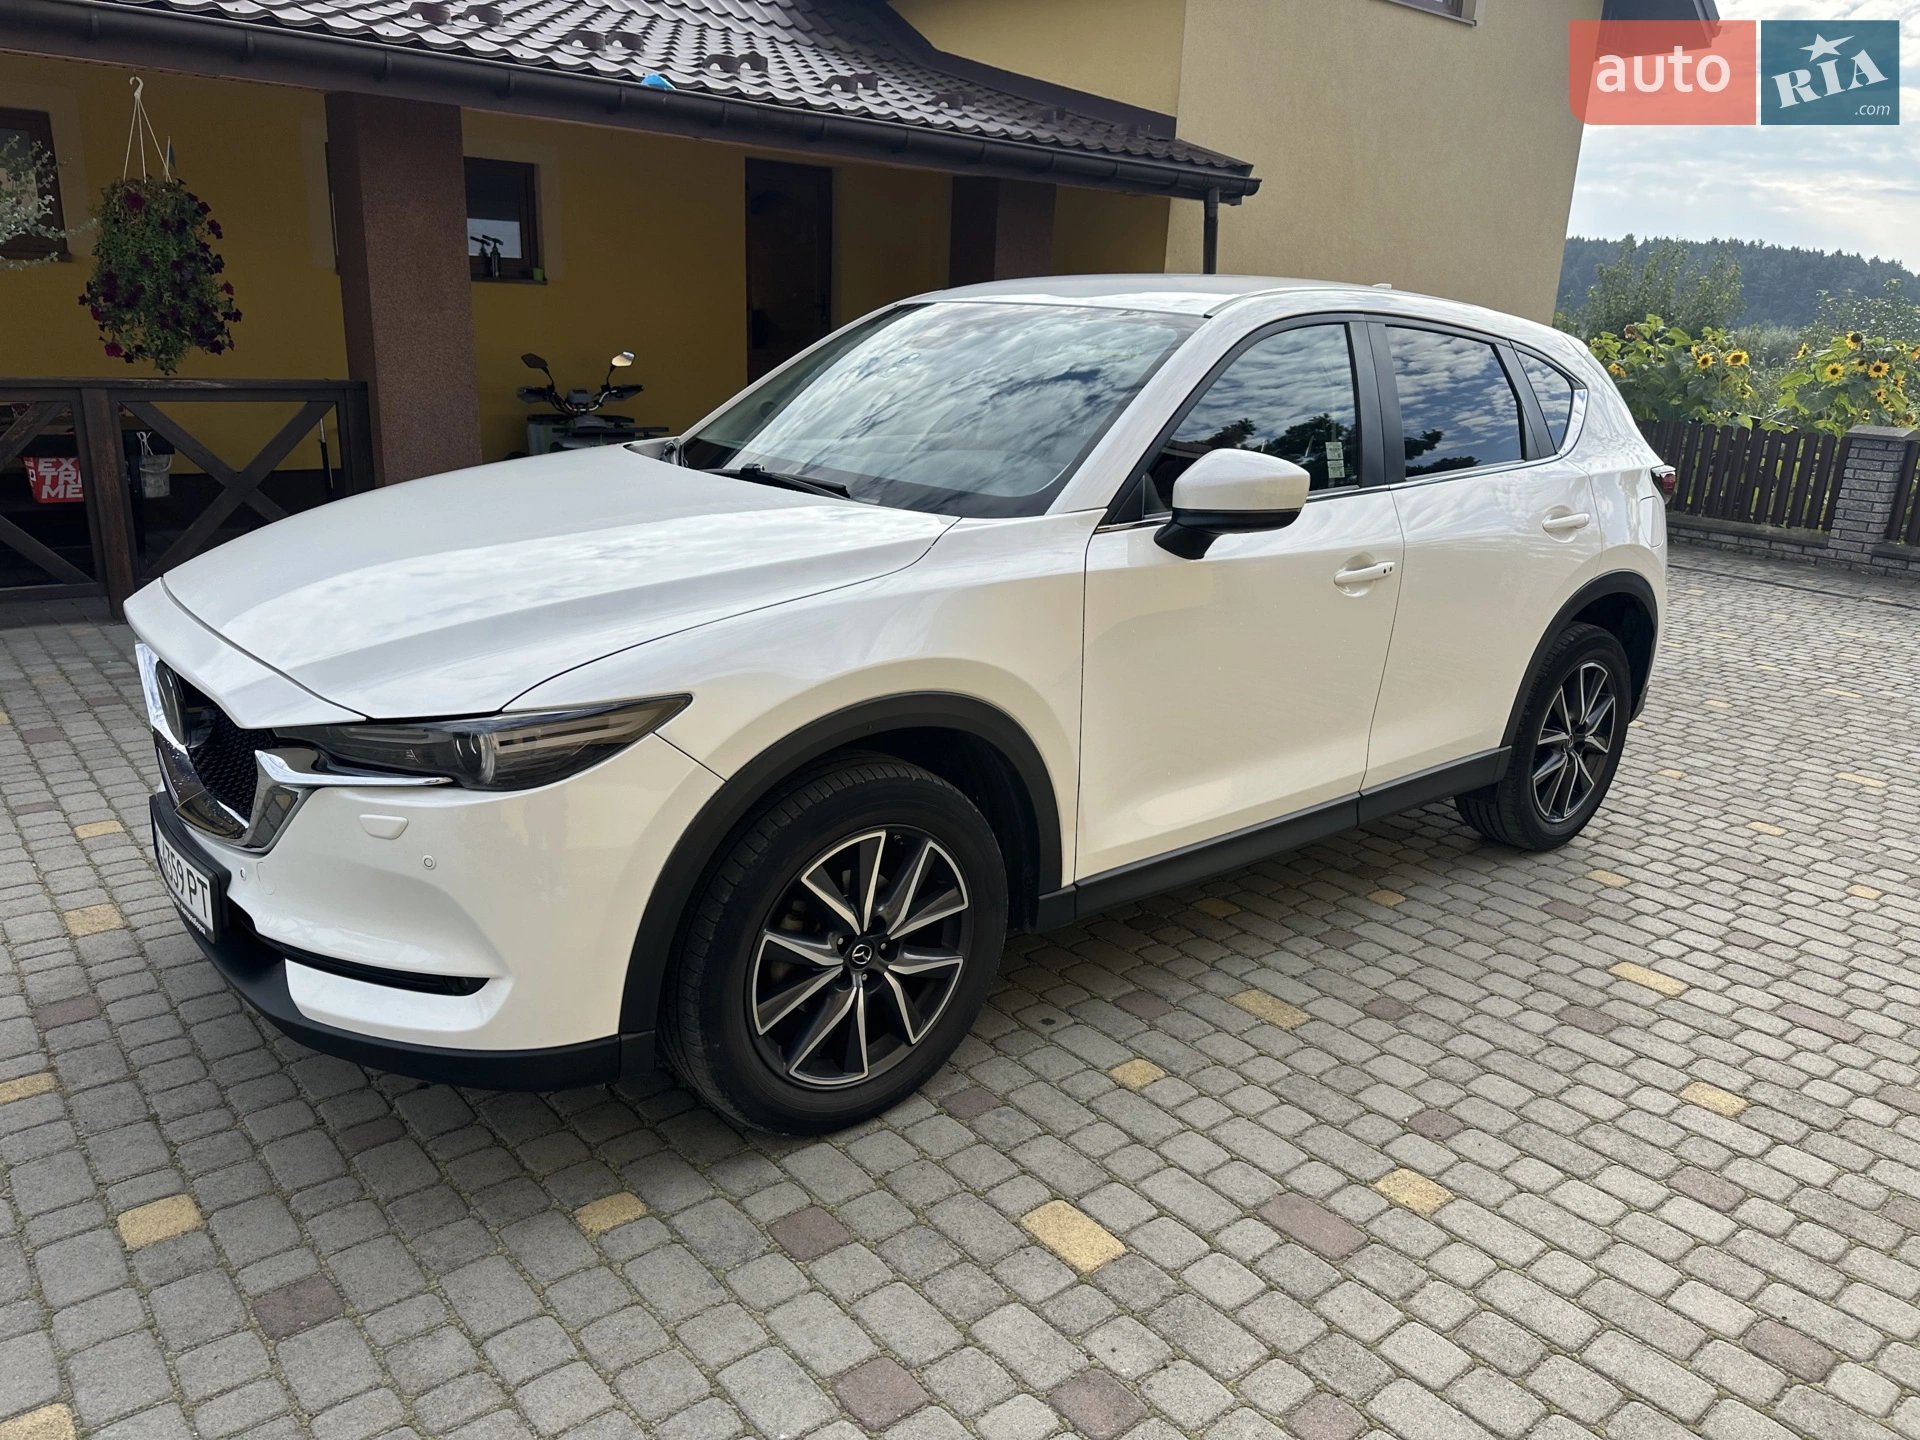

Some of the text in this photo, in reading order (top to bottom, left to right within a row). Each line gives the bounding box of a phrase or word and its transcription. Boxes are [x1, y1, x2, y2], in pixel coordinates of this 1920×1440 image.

[38, 457, 77, 472] EX
[41, 485, 84, 499] ME
[186, 868, 208, 918] PT
